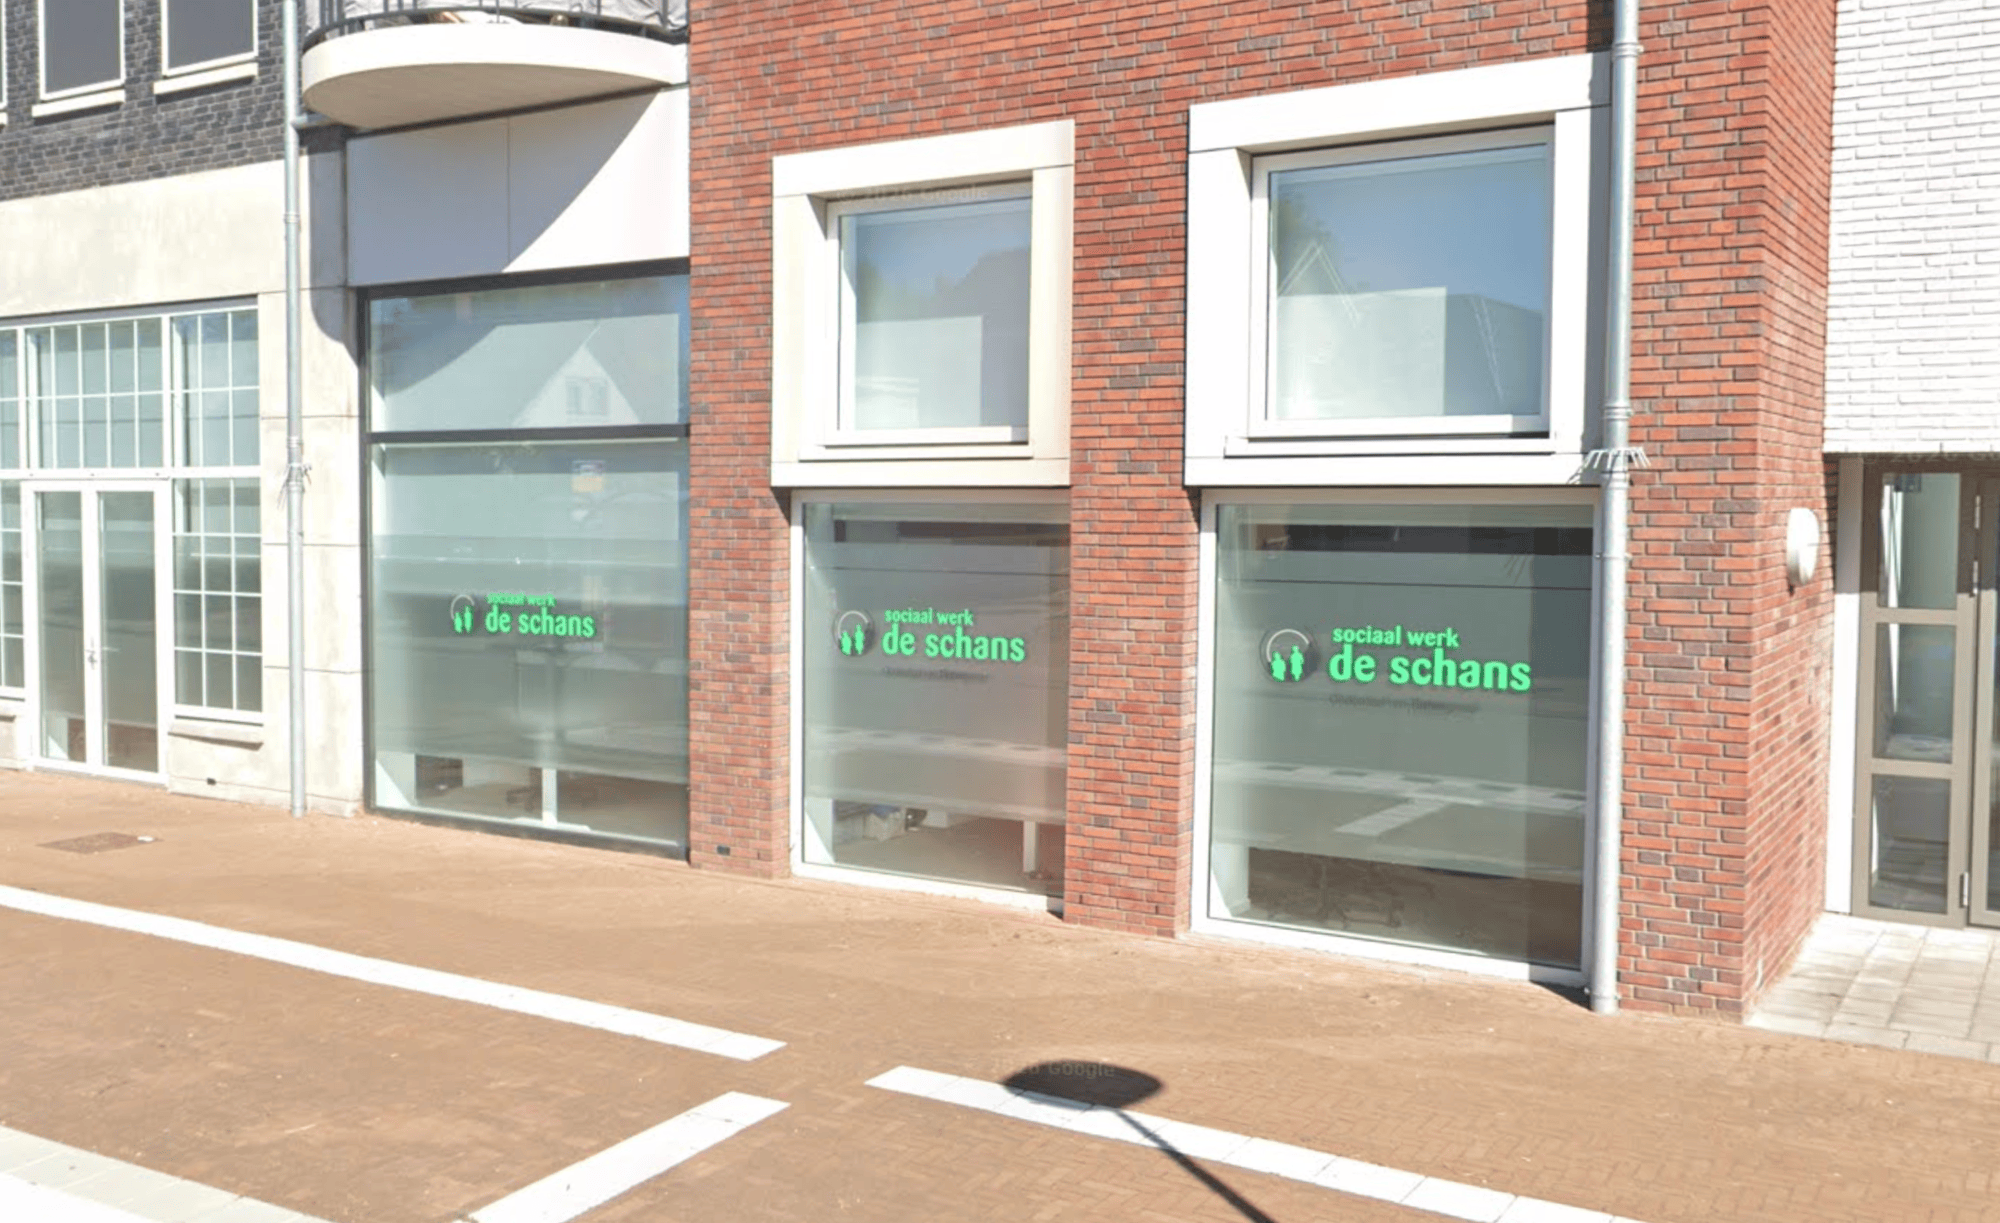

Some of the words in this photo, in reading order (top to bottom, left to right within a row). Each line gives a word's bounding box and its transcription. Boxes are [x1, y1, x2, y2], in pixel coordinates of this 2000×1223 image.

[527, 593, 557, 607] werk
[485, 604, 512, 633] de
[518, 605, 596, 638] schans
[884, 607, 934, 624] sociaal
[936, 609, 974, 626] werk
[881, 623, 916, 656] de
[924, 625, 1026, 662] schans
[1332, 625, 1402, 645] sociaal
[1407, 627, 1460, 648] werk
[1329, 643, 1376, 682] de
[1390, 647, 1532, 691] schans
